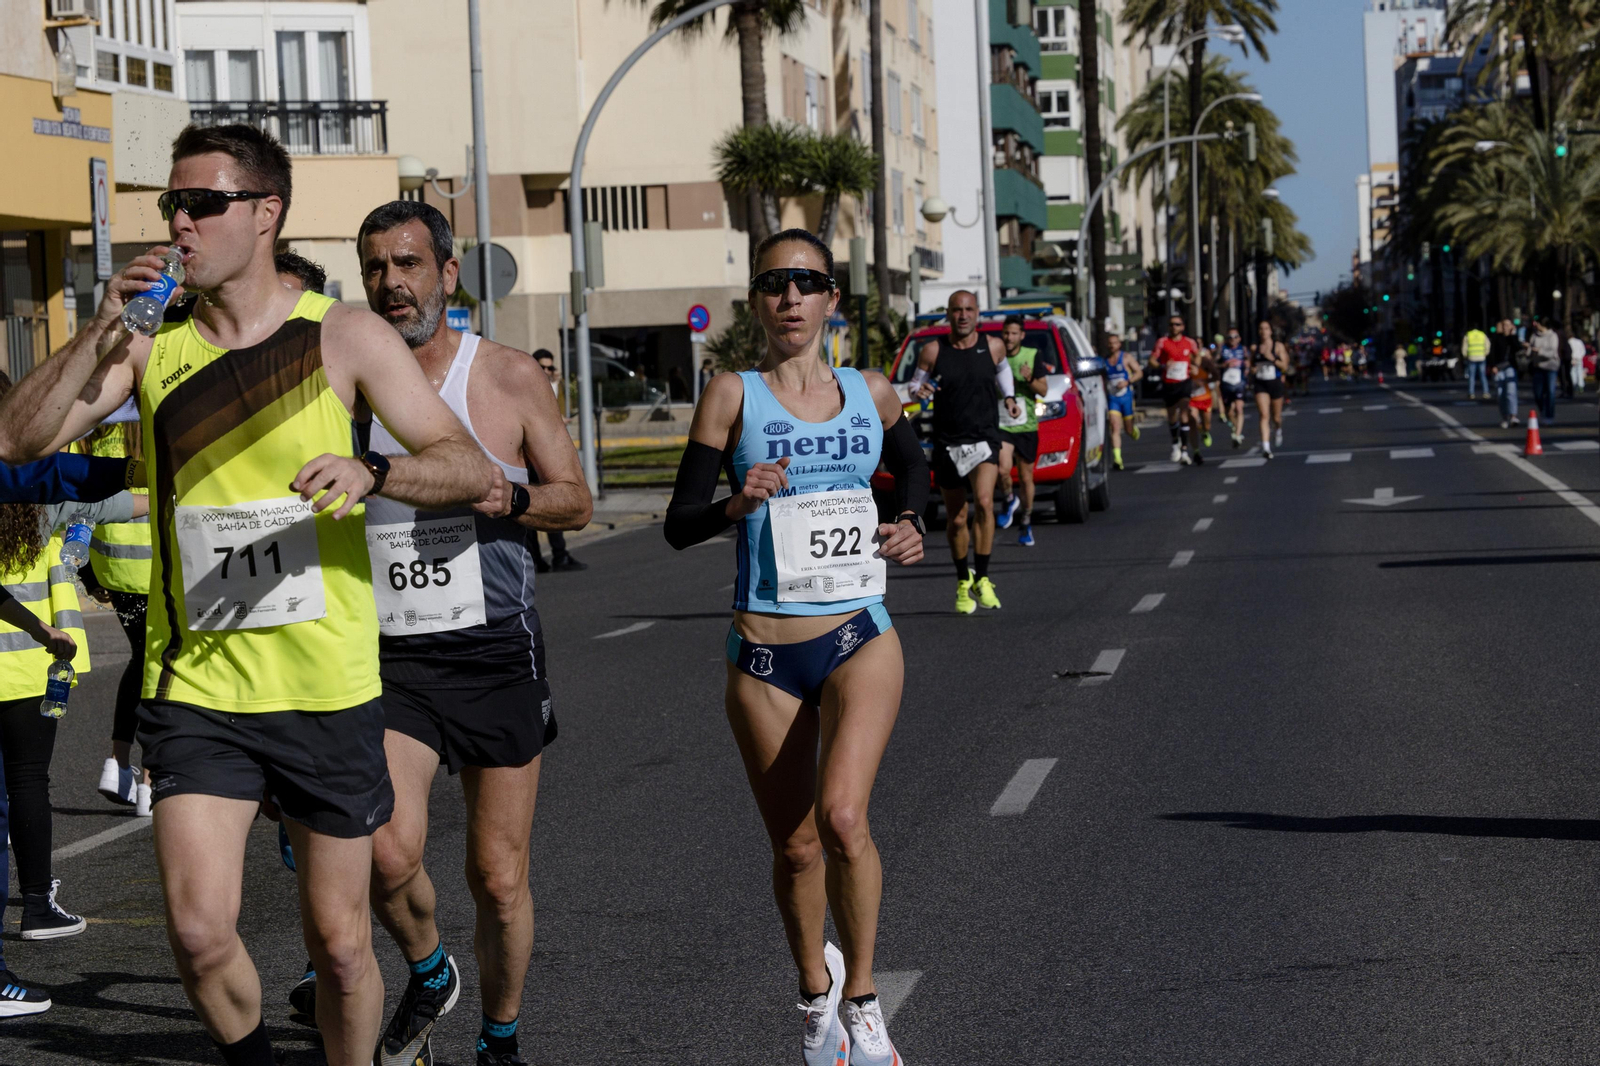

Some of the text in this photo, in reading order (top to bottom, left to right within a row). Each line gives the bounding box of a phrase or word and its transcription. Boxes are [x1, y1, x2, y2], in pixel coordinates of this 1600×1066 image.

[765, 423, 793, 434] TROPS
[766, 428, 871, 460] nerja
[785, 463, 857, 477] ATLETISMO
[798, 483, 819, 491] metro
[797, 500, 818, 510] XXXV
[820, 497, 846, 507] MEDIA
[201, 503, 310, 522] XXXV MEDIA MARATÓN
[811, 508, 837, 518] BAHÍA
[838, 506, 848, 515] DE
[217, 516, 297, 532] BAHÍA DE CÁDIZ
[376, 523, 473, 541] XXXV MEDIA MARATÓN
[389, 535, 461, 550] BAHÍA DE CÁDIZ
[809, 526, 861, 559] 522
[213, 541, 282, 579] 711
[388, 557, 452, 591] 685
